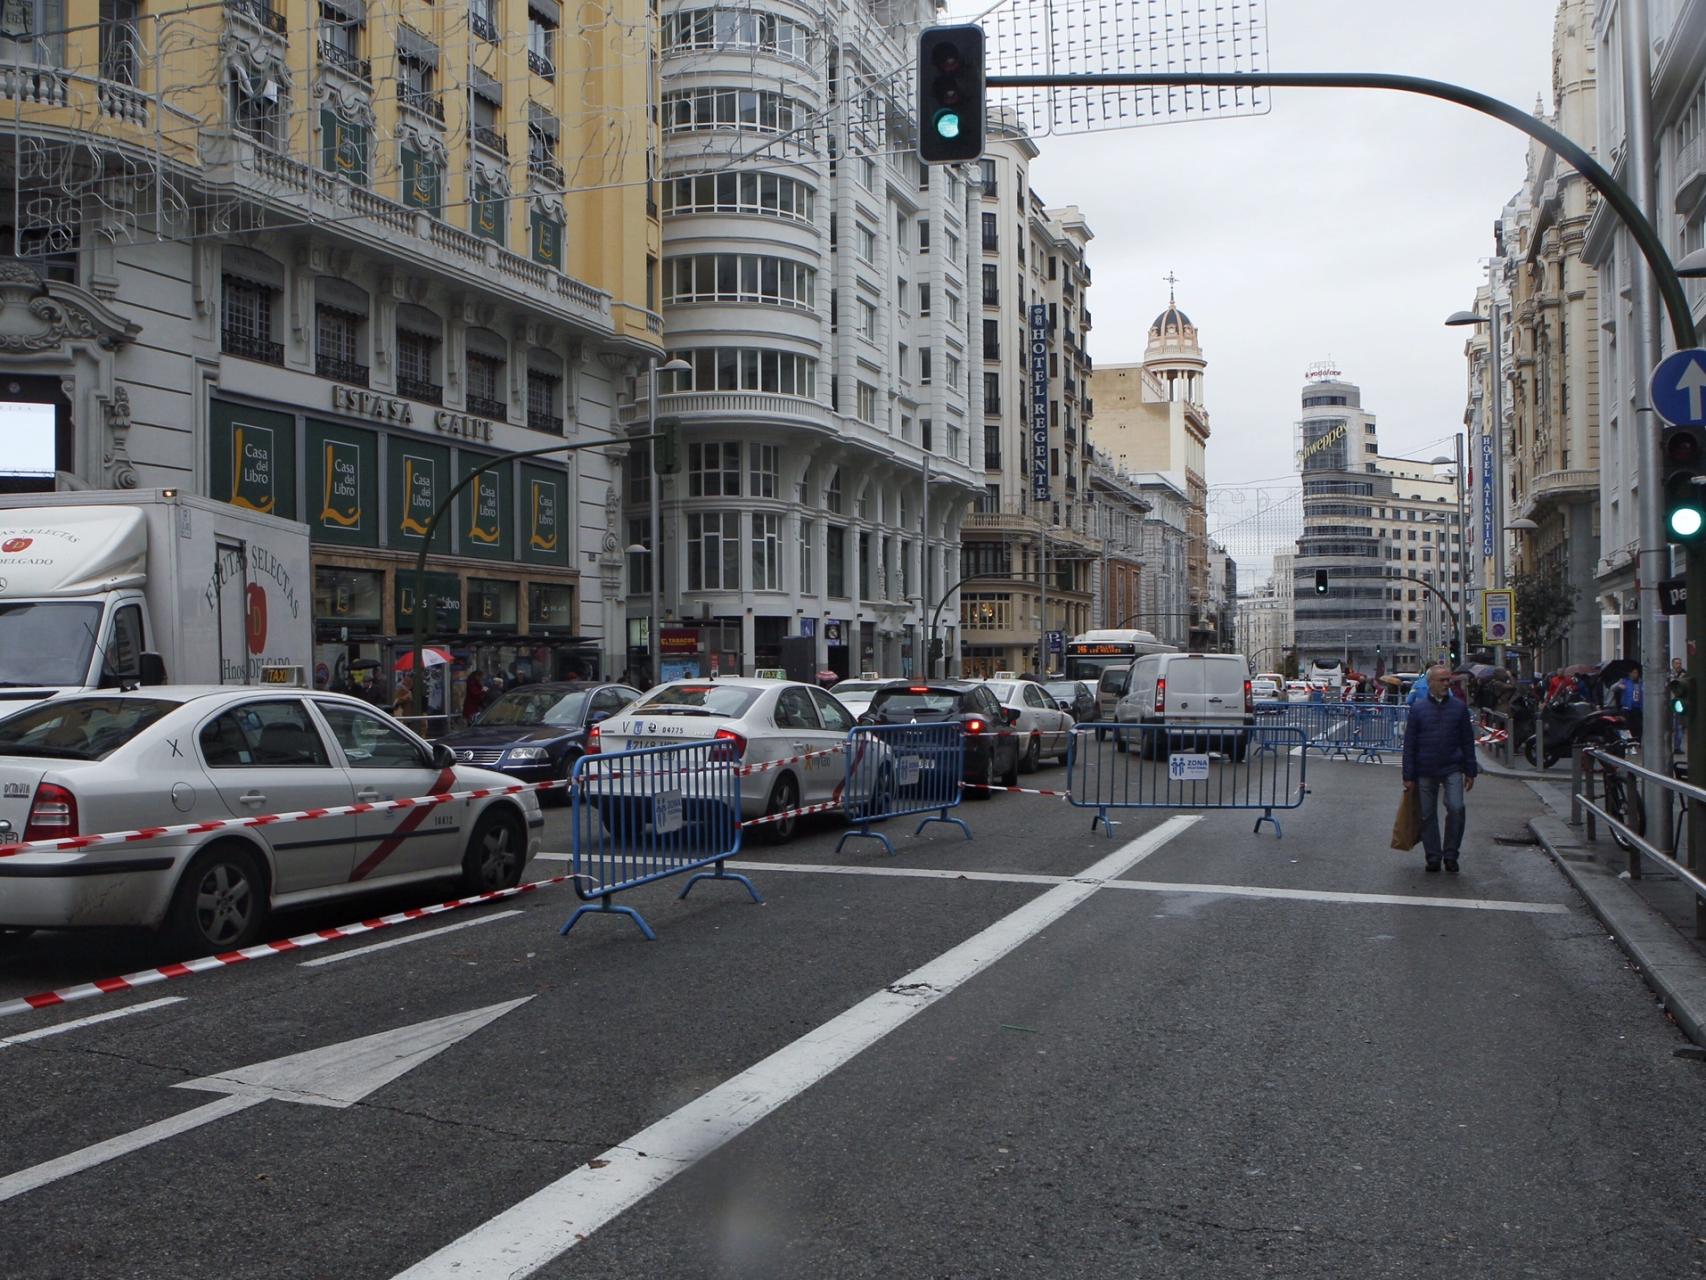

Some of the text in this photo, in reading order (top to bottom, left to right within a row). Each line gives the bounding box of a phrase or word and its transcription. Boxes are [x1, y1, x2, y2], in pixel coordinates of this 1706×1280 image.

[333, 385, 494, 441] ESPASA CALPE
[1032, 327, 1048, 500] HOTEL REGENTE
[245, 443, 268, 460] Casa
[256, 461, 269, 472] del
[334, 459, 355, 474] Casa
[244, 467, 269, 484] Libro
[344, 474, 356, 485] del
[412, 472, 431, 487] Casa
[334, 481, 355, 497] Libro
[421, 487, 432, 497] del
[480, 484, 496, 498] Casa
[1482, 437, 1492, 556] HOTEL ATLANTICO
[412, 494, 431, 508] Libro
[480, 504, 497, 518] Libro
[251, 544, 299, 620] SELECTAS
[267, 669, 289, 683] TAXI
